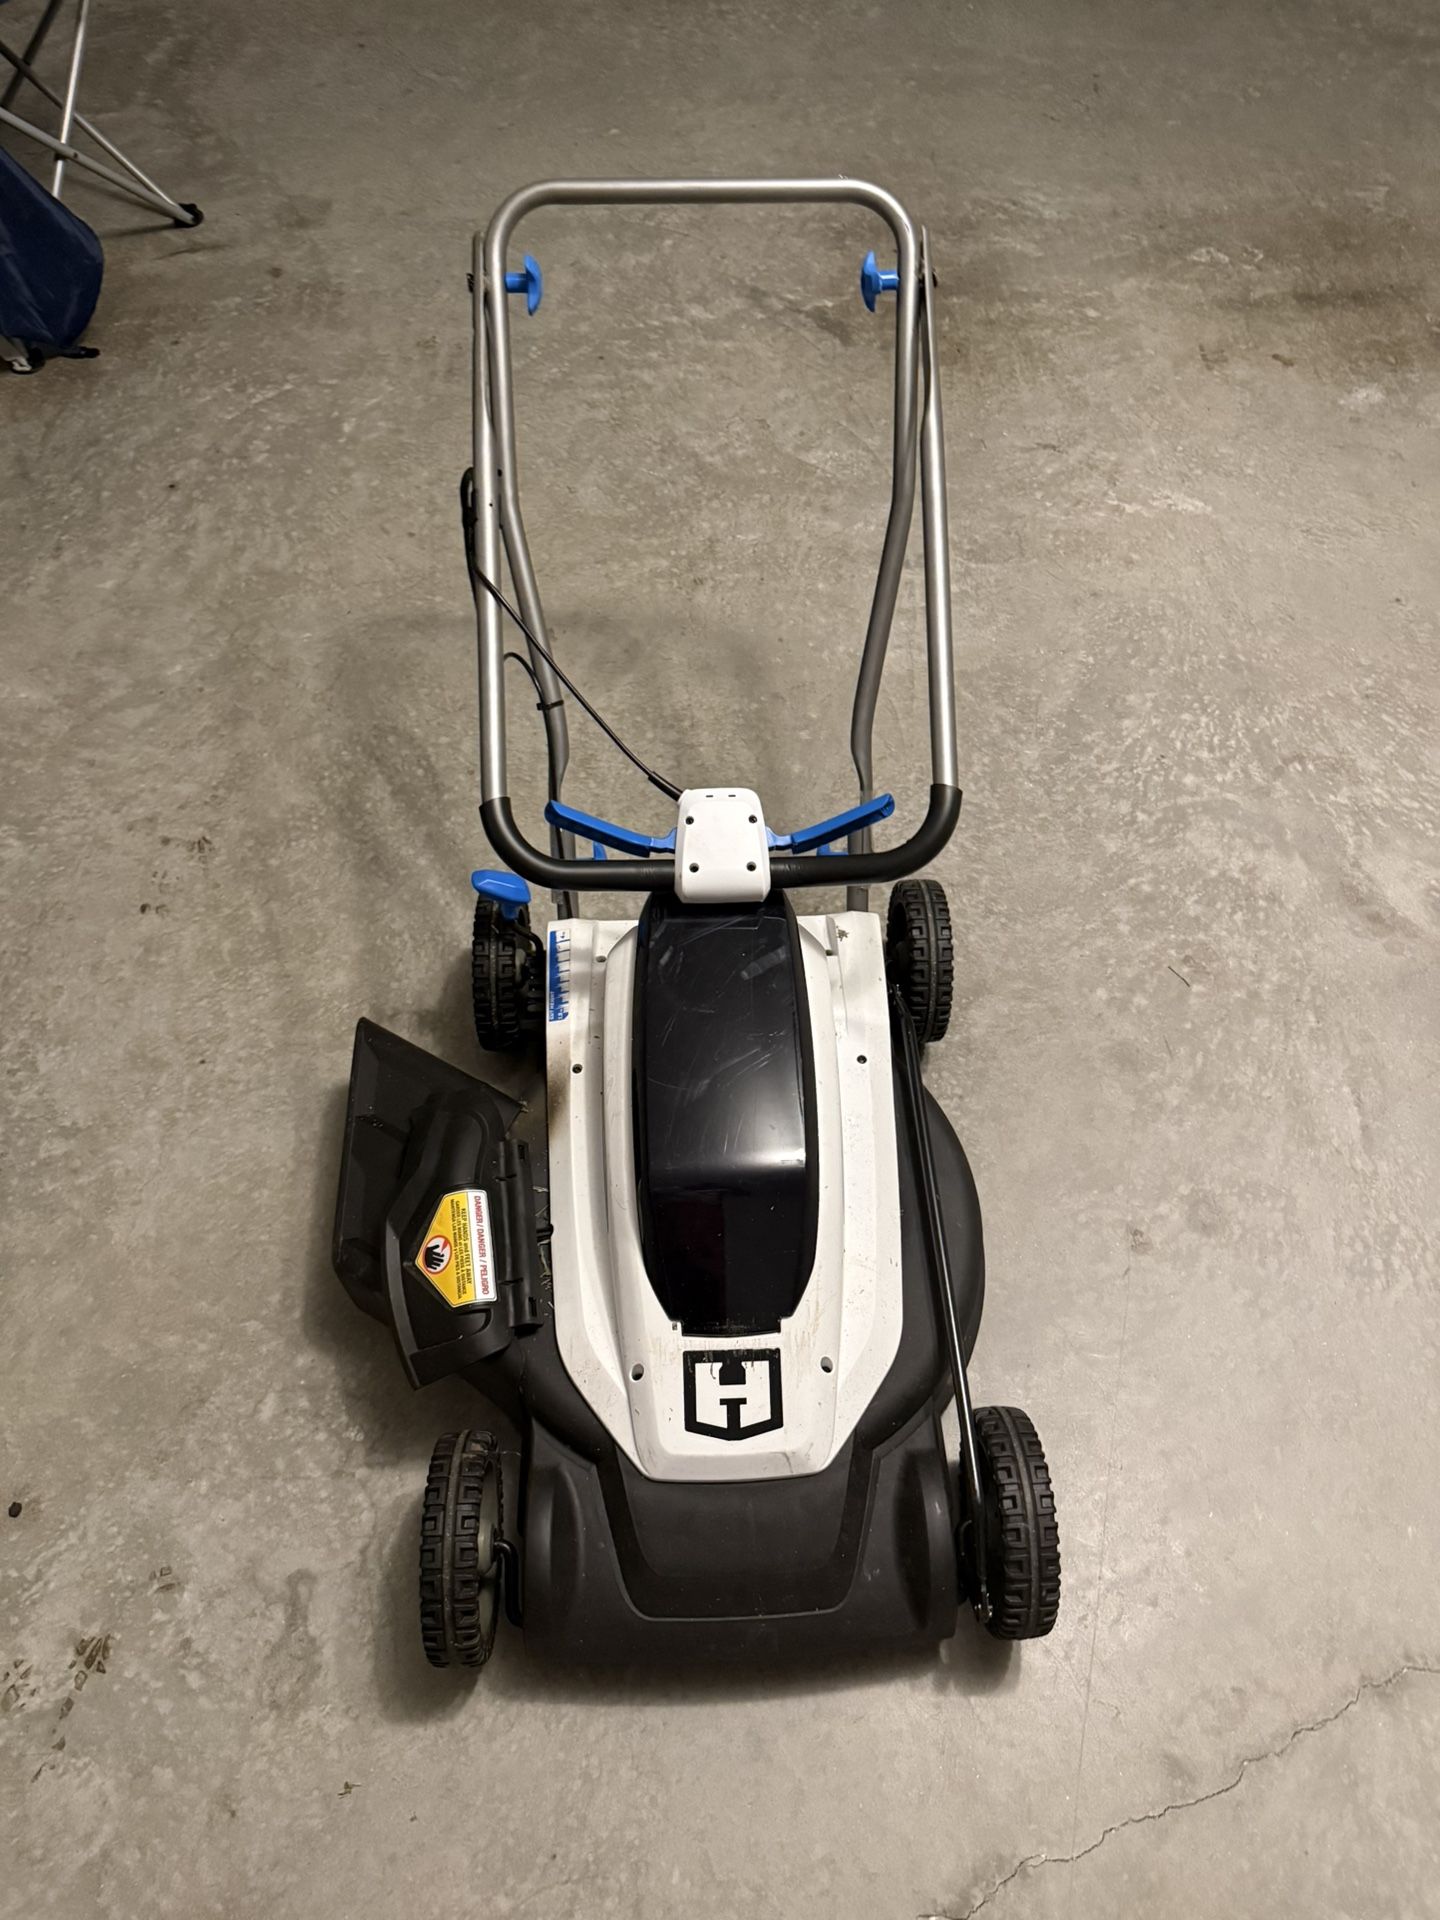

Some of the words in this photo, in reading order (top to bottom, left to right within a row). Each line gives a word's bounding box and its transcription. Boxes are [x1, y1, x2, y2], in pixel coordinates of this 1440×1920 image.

[474, 1196, 483, 1223] DANGER
[477, 1229, 486, 1258] DANGER
[480, 1265, 489, 1294] PELIGRO
